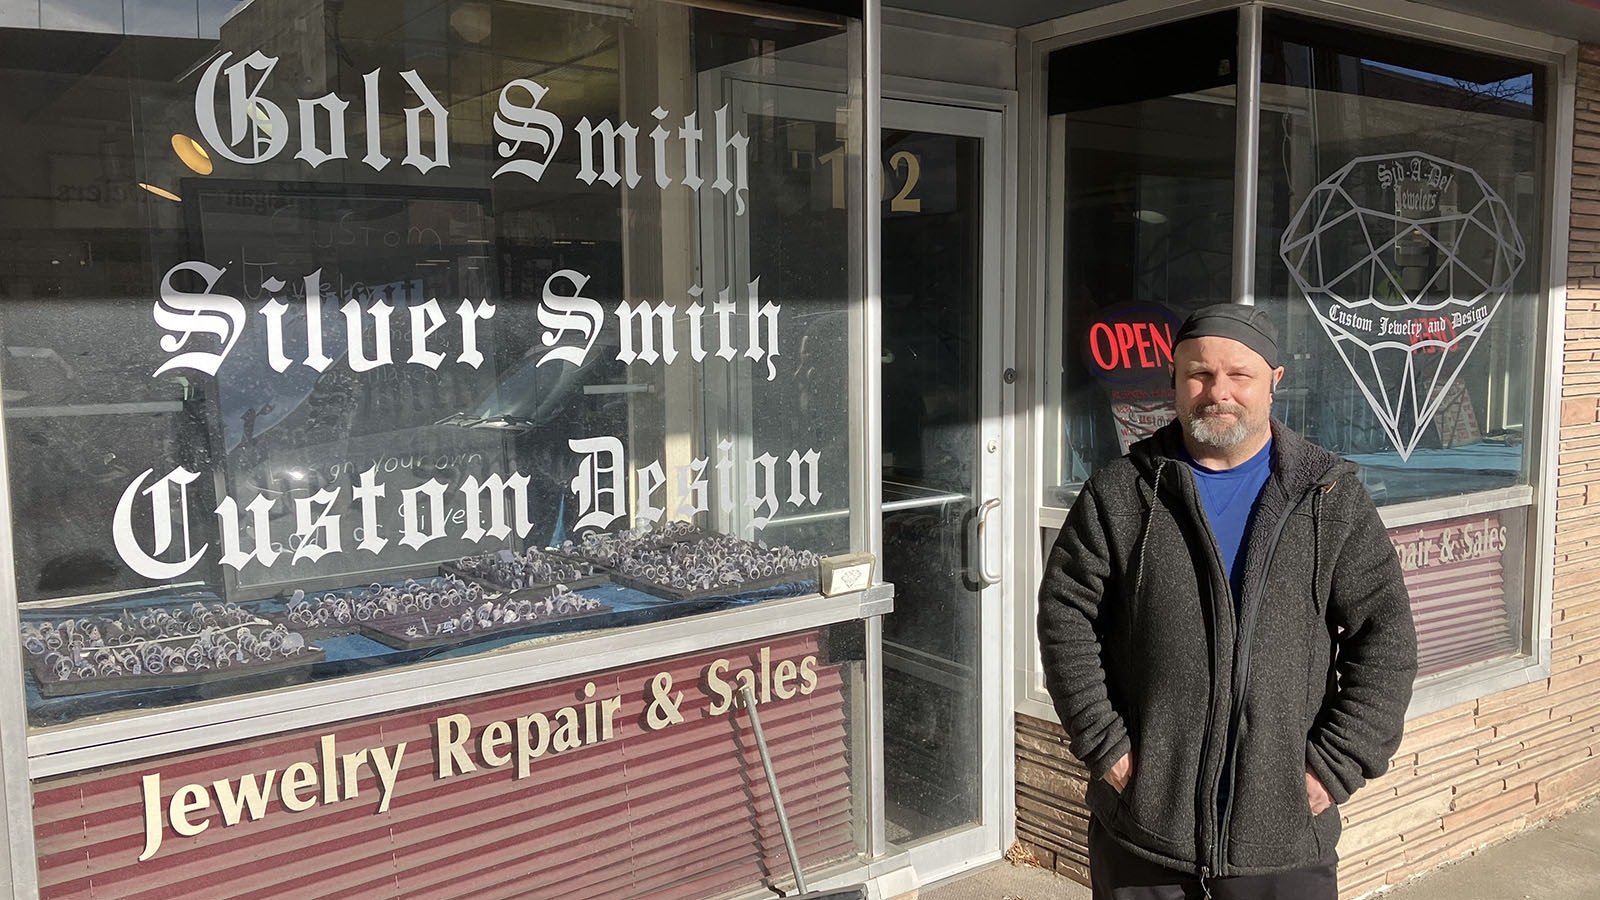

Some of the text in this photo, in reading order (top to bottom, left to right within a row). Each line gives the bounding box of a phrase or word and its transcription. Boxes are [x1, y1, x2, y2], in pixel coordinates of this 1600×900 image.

[195, 50, 751, 216] Gold Smith
[818, 146, 921, 213] 12
[152, 261, 781, 382] Silver Smith
[1089, 322, 1174, 371] OPEN
[1328, 303, 1488, 338] Custom Jewelry and Design
[112, 436, 822, 580] Custom Design
[1440, 528, 1455, 563] &
[1463, 518, 1507, 559] Sales
[138, 647, 818, 862] Jewelry Repair & Sales
